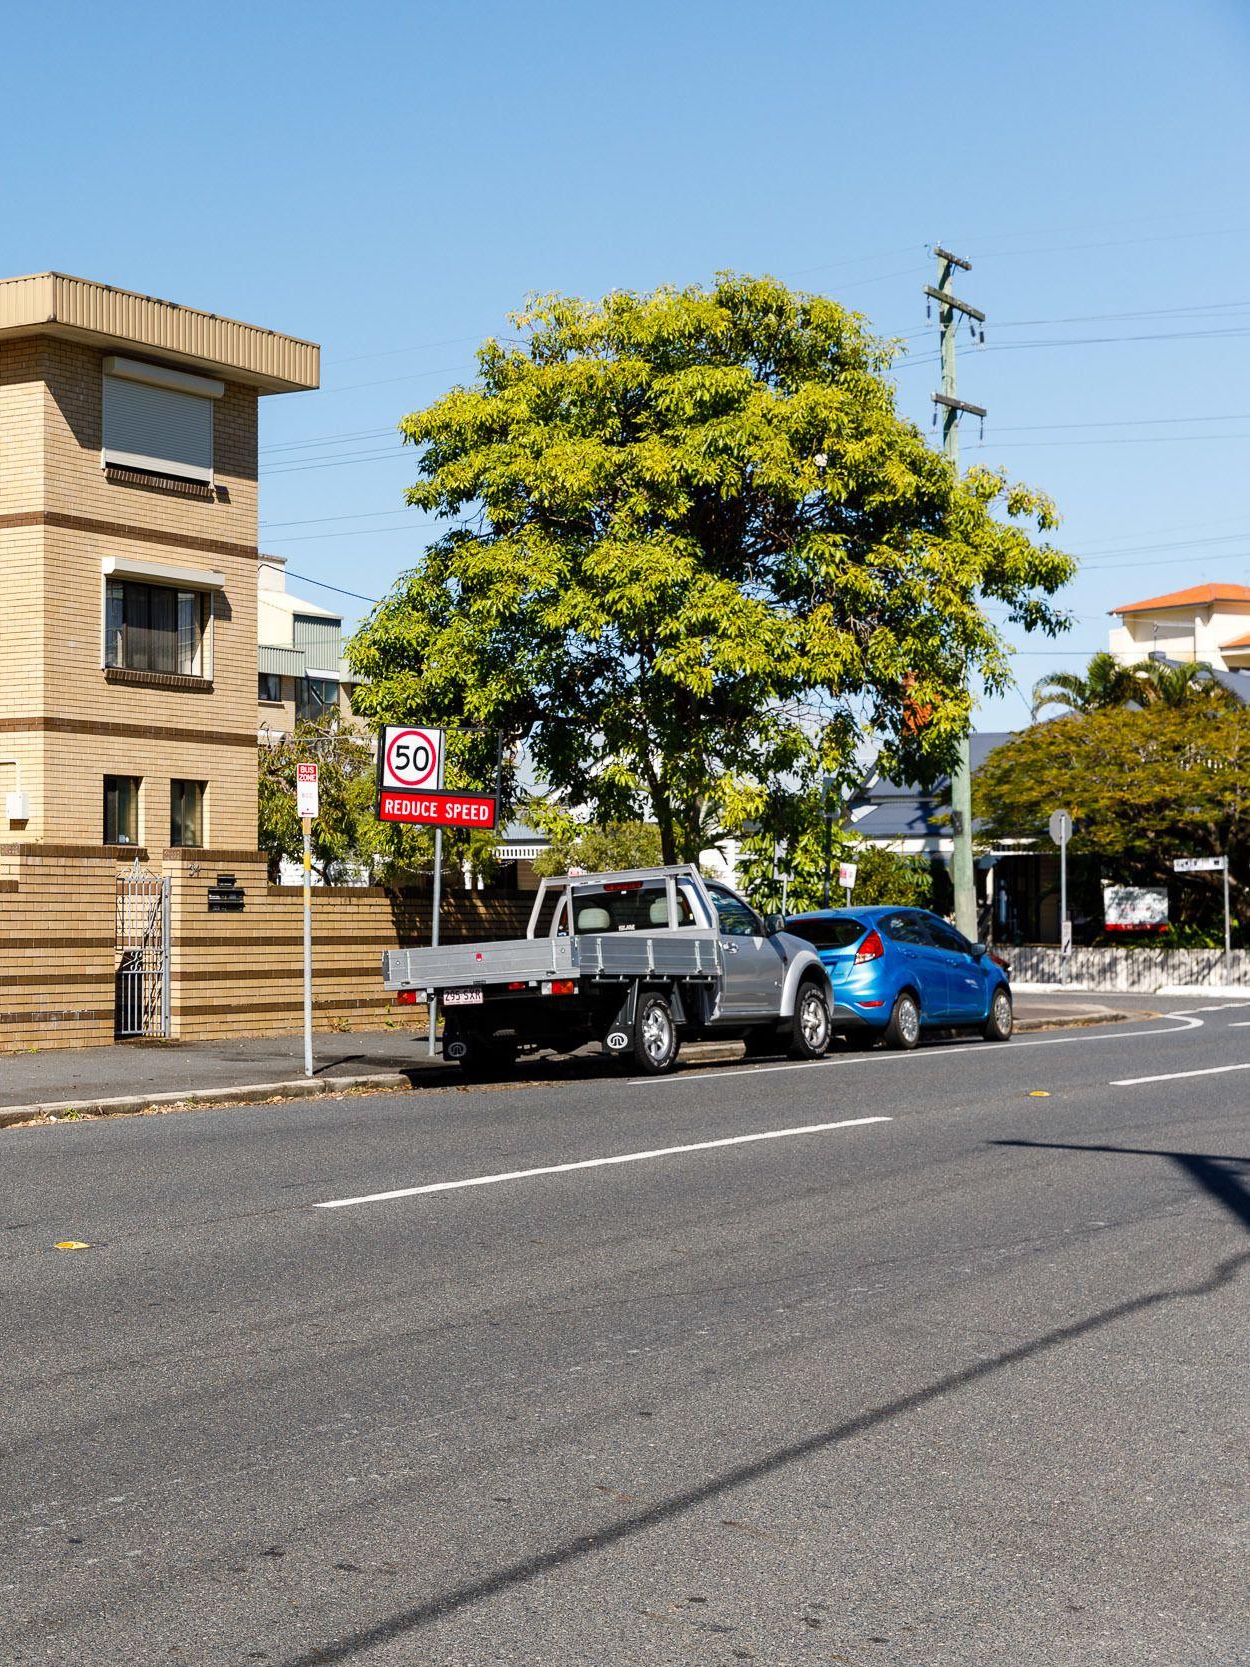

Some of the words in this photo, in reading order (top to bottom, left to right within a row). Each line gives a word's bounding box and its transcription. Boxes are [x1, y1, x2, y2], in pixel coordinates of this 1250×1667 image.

[394, 745, 430, 772] 50
[299, 766, 315, 774] BUS
[385, 799, 438, 817] REDUCE
[445, 802, 489, 821] SPEED
